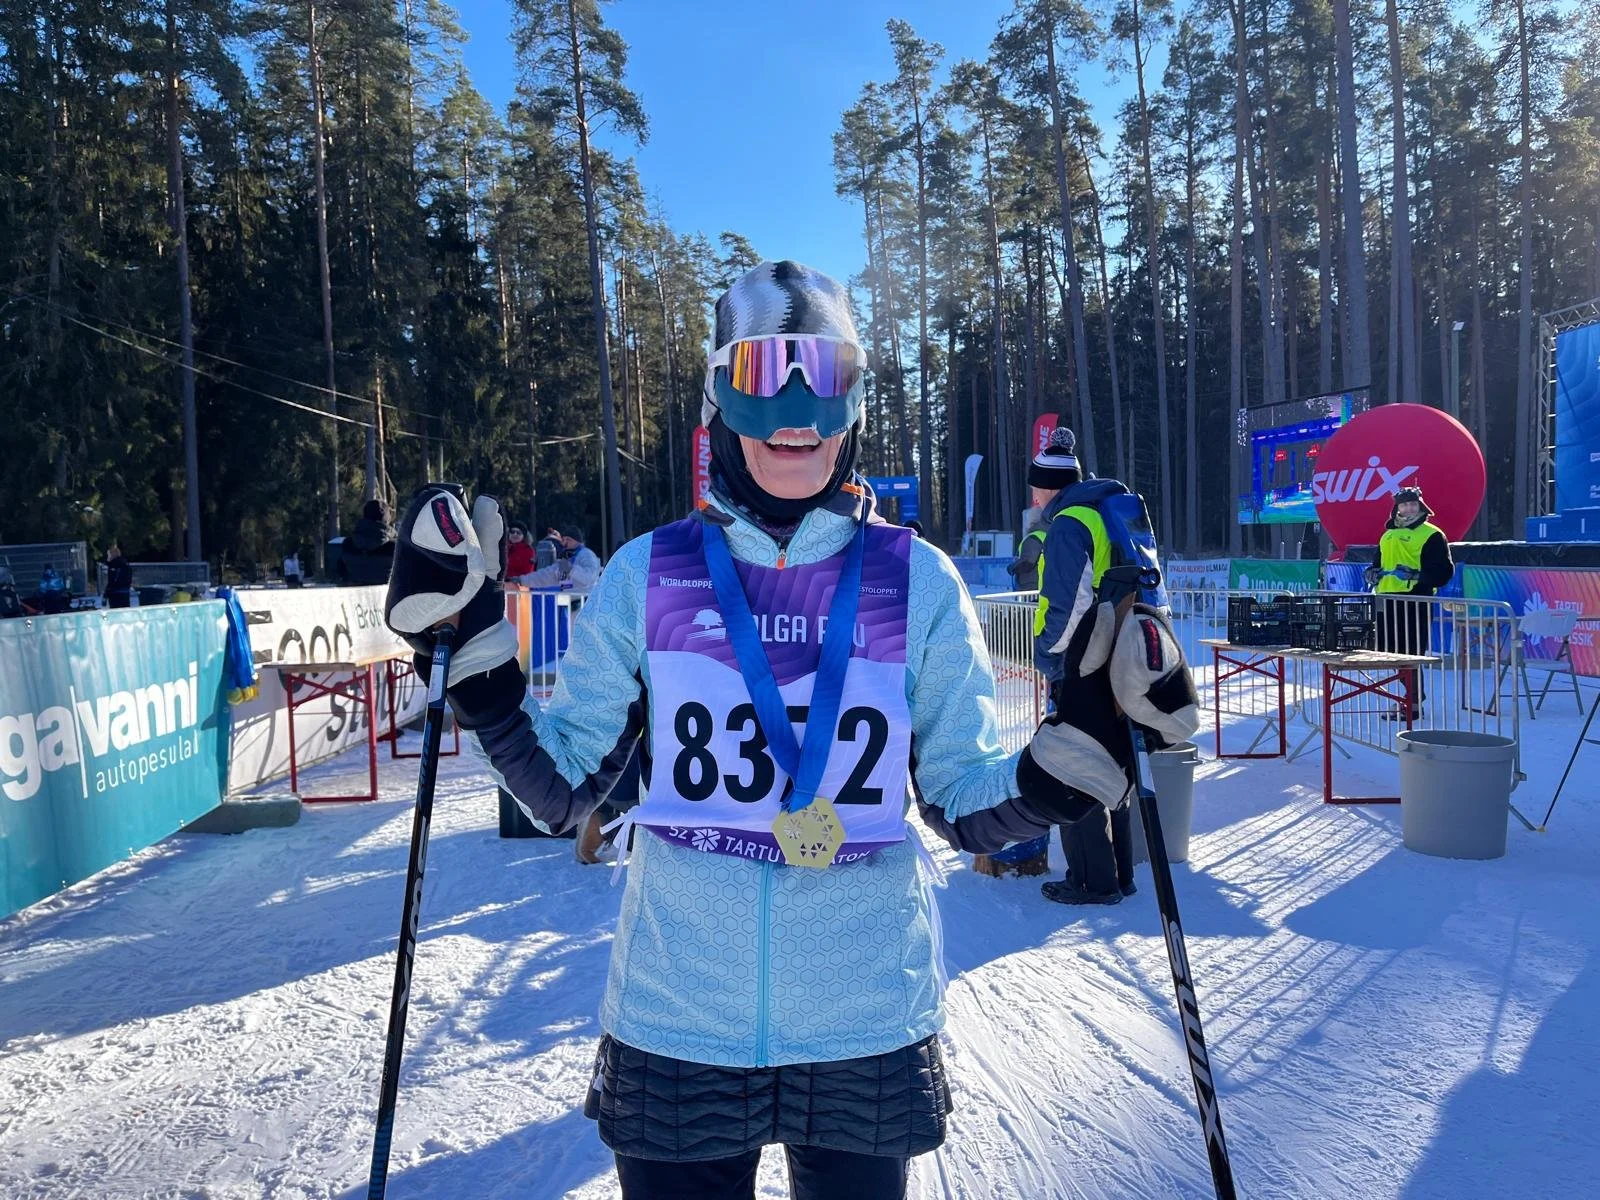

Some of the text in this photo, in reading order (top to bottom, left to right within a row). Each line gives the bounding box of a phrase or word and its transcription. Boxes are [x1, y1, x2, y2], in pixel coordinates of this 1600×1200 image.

[660, 576, 713, 588] WORLDLOPPE
[751, 614, 807, 643] LGA
[673, 701, 889, 805] 832
[725, 836, 781, 863] TARTU
